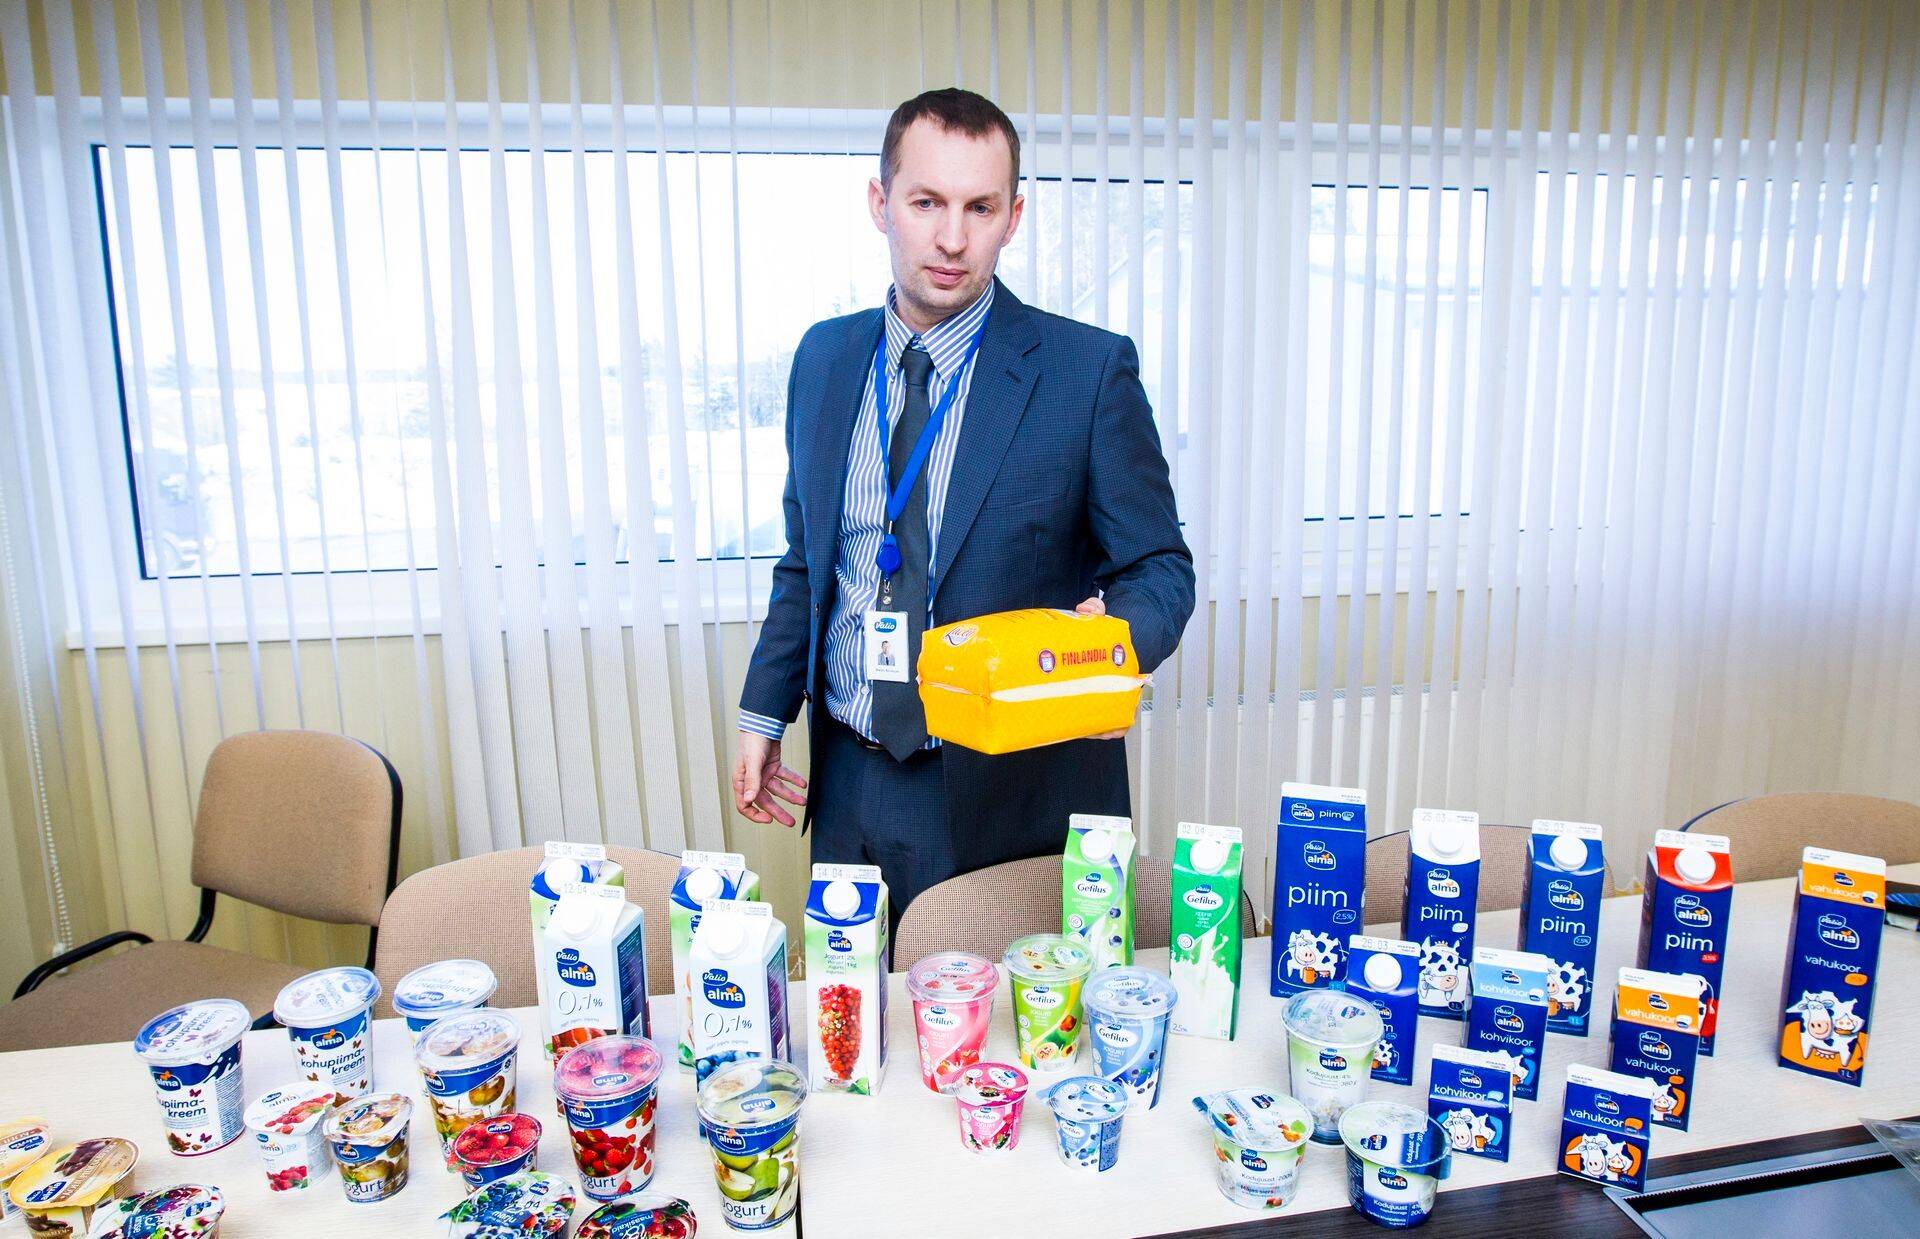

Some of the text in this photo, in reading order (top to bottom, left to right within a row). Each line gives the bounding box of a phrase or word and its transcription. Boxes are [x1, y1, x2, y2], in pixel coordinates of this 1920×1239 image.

[875, 621, 895, 630] Valio
[1062, 648, 1107, 666] FINLANDIA
[1319, 810, 1342, 820] piim
[1307, 854, 1334, 865] alma
[1077, 882, 1107, 894] Gefilus
[1430, 882, 1458, 893] alma
[1186, 894, 1217, 906] Gefilus
[1288, 881, 1348, 908] piim
[1551, 894, 1581, 906] alma
[1420, 904, 1463, 923] piim
[1678, 909, 1709, 922] alma
[1540, 915, 1586, 936] piim
[1664, 931, 1714, 954] piim
[1822, 930, 1857, 944] alma
[831, 940, 851, 949] alma
[556, 951, 578, 961] Valio
[1805, 955, 1861, 974] vahukoor
[561, 963, 595, 982] alma
[703, 972, 727, 983] Valio
[707, 985, 744, 1002] alma
[1025, 993, 1056, 1004] Gefilus
[923, 1013, 955, 1026] Gefilus
[1496, 1017, 1522, 1028] alma
[1098, 1027, 1129, 1042] Gefilus
[1479, 1030, 1534, 1046] kohvikoor
[315, 1035, 343, 1048] alma
[1642, 1043, 1670, 1056] alma
[300, 1047, 366, 1069] kohupiima-
[1321, 1057, 1346, 1069] alma
[330, 1054, 366, 1076] kreem
[1625, 1057, 1682, 1075] vahukoor
[155, 1078, 180, 1087] alma
[594, 1073, 629, 1085] alma
[1460, 1076, 1480, 1087] alma
[1433, 1085, 1488, 1103] kohvikoor
[741, 1097, 775, 1112] alma
[1597, 1101, 1618, 1113] alma
[167, 1106, 207, 1118] kreem
[570, 1107, 591, 1118] alma
[1569, 1108, 1625, 1129] vahukoor
[488, 1124, 512, 1134] alma
[719, 1135, 744, 1147] alma
[1242, 1159, 1267, 1170] alma
[1380, 1176, 1407, 1188] alma
[1373, 1199, 1408, 1212] Kodujuust
[611, 1209, 655, 1234] maasikaid
